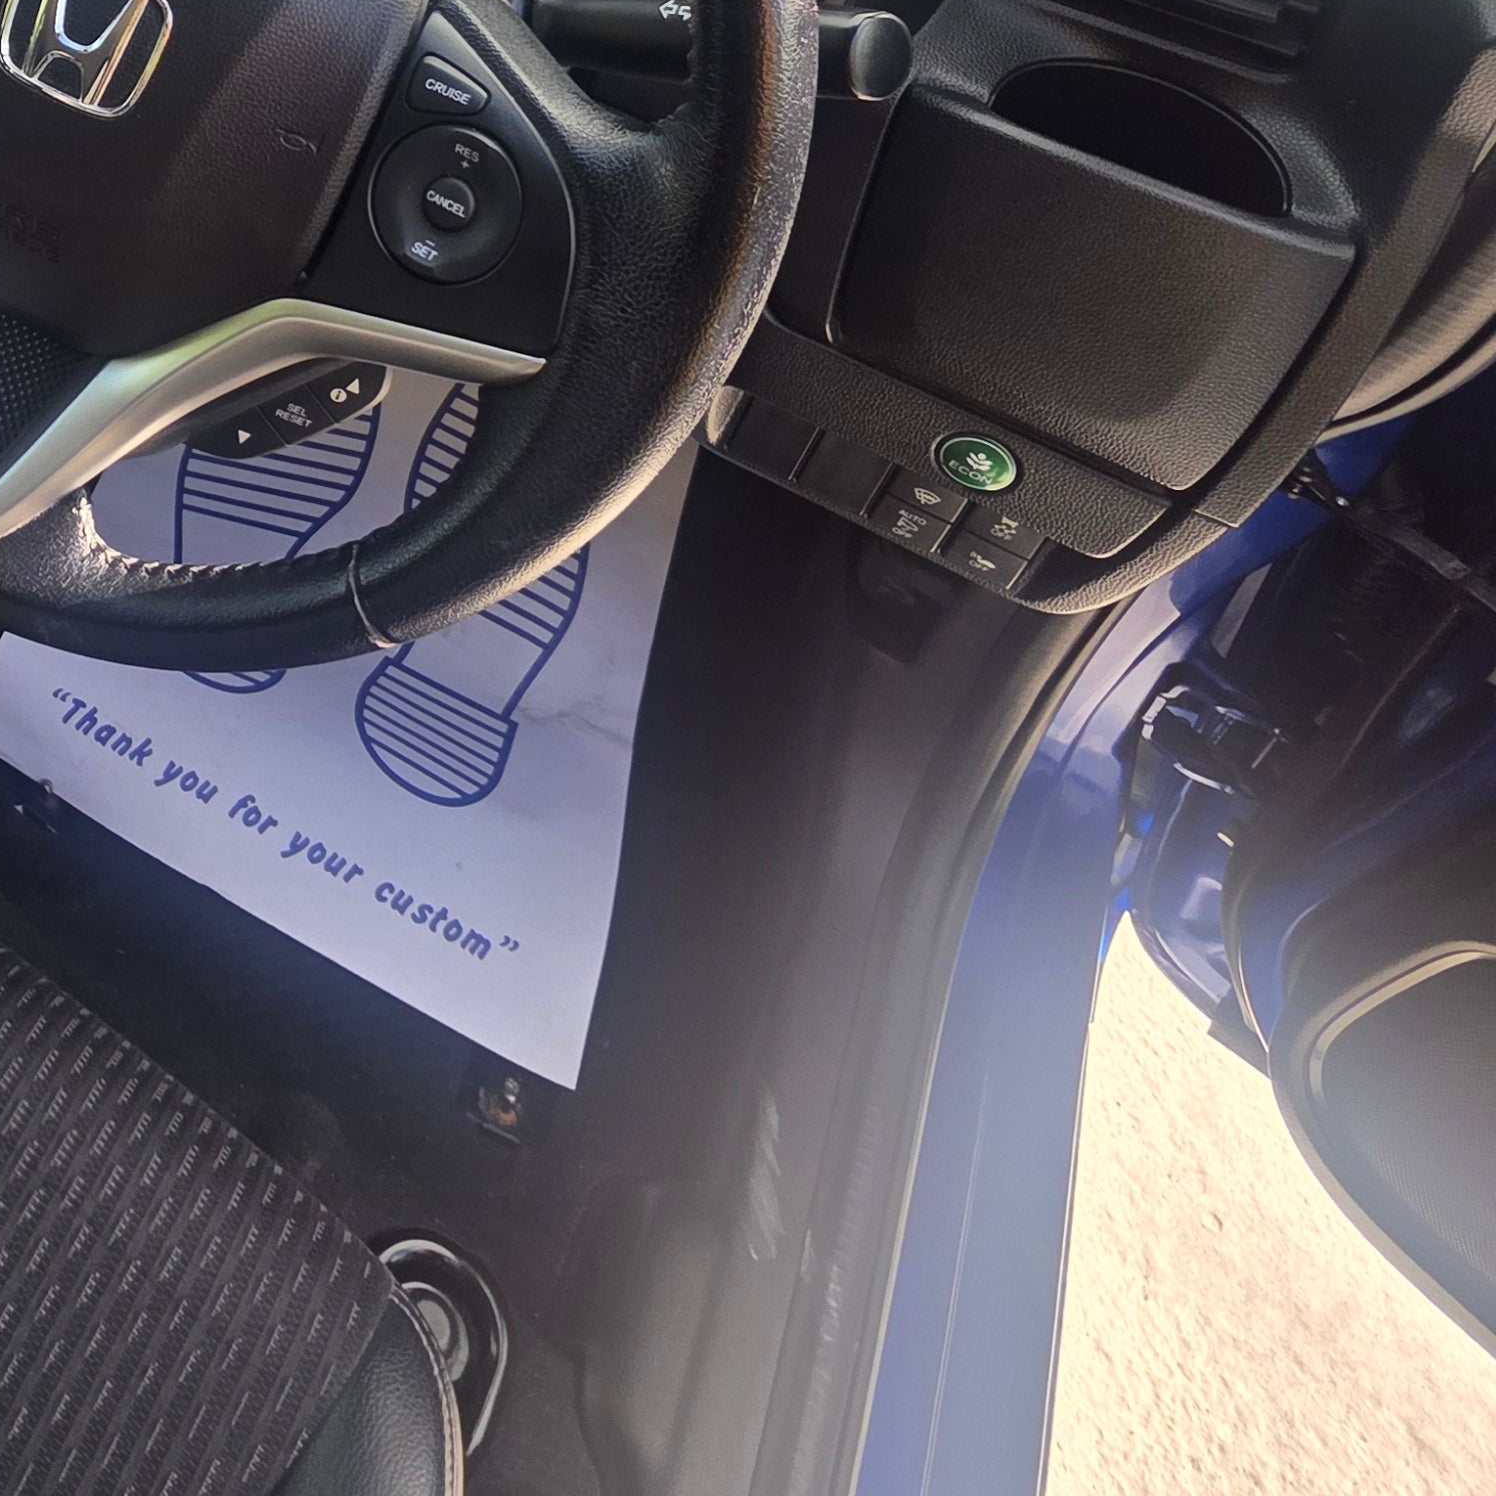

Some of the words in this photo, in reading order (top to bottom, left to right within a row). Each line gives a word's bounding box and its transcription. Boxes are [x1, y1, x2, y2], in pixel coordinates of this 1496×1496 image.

[424, 78, 472, 105] CRUISE
[454, 143, 480, 163] RES
[426, 189, 466, 219] CANCEL
[411, 241, 439, 262] SET
[274, 408, 313, 429] RESET
[286, 403, 307, 417] SEL
[948, 459, 993, 485] ECON
[898, 509, 928, 526] AUTO
[154, 760, 219, 804] you
[228, 794, 279, 835] for
[280, 831, 364, 884] your
